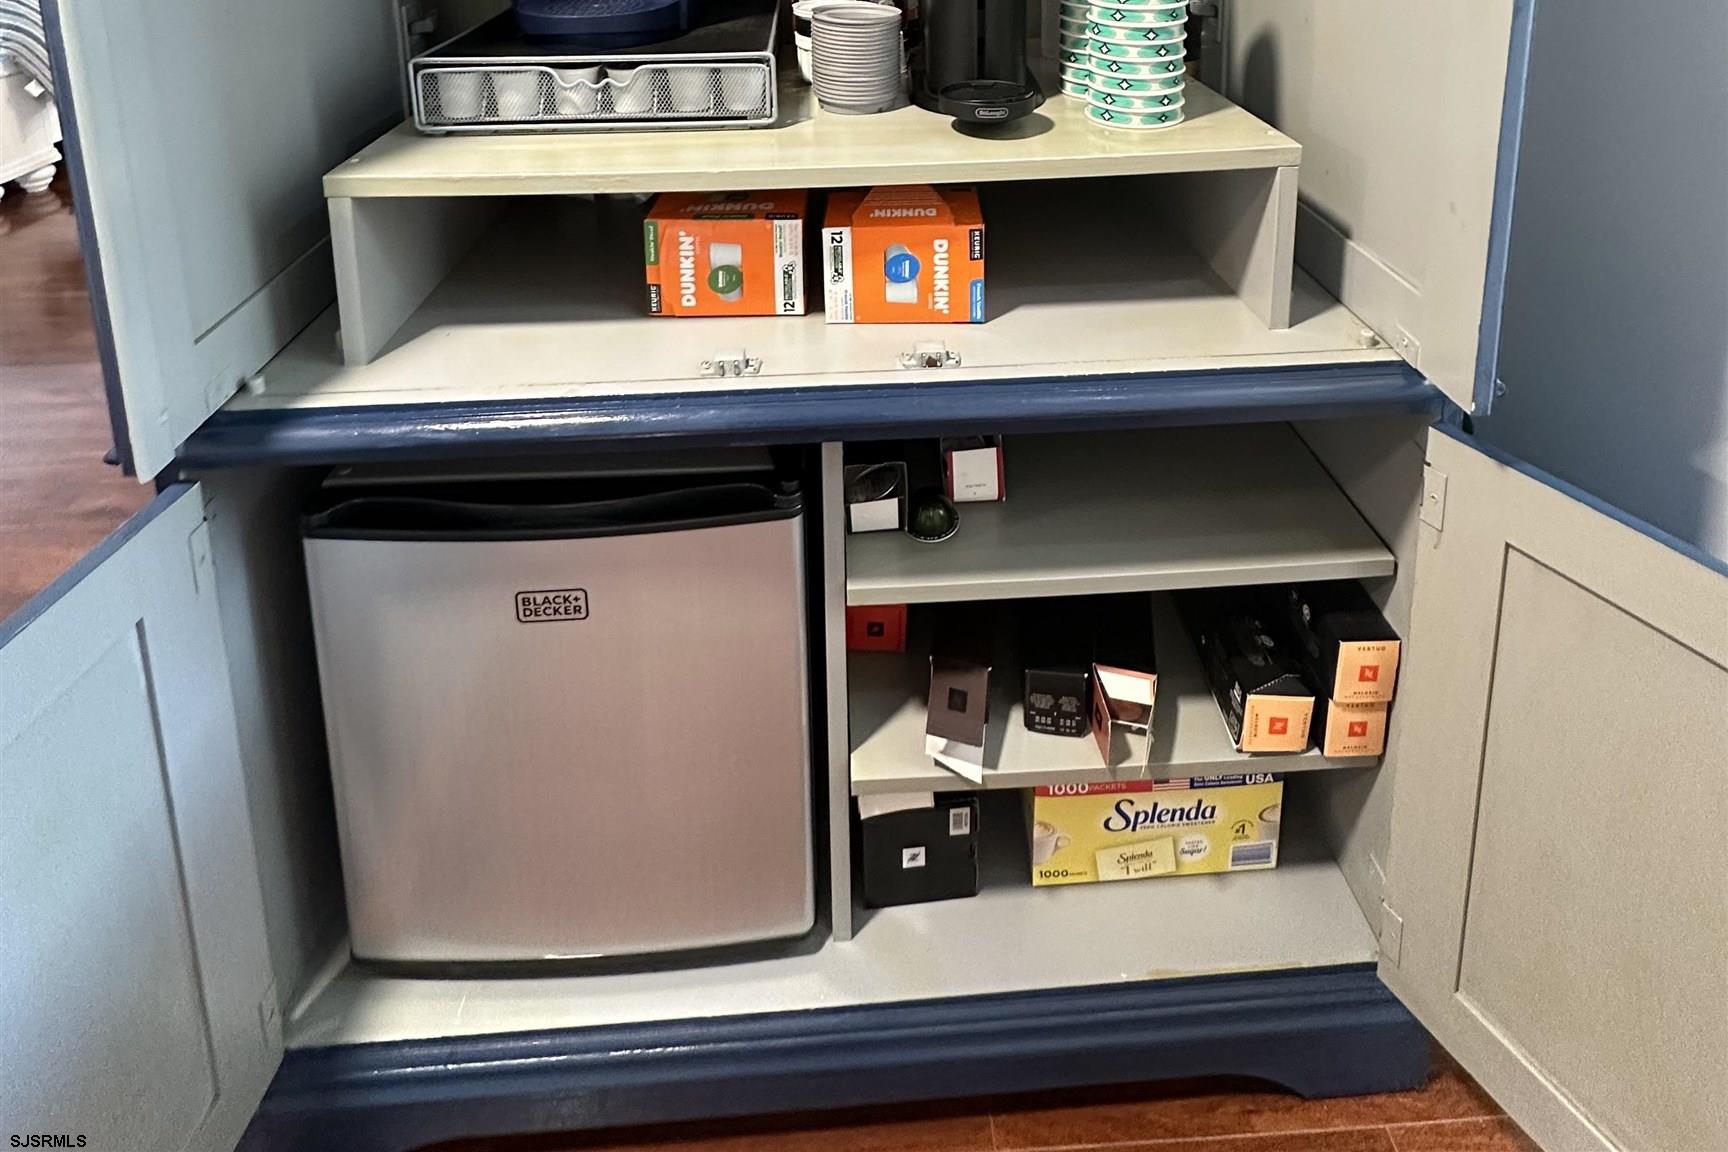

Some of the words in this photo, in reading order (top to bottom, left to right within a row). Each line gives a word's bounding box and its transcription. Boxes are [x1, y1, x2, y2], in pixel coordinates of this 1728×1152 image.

[870, 207, 937, 218] DUNKIN'
[830, 231, 843, 244] 12
[973, 231, 981, 259] KEURIG
[678, 231, 697, 308] DUNKIN'
[933, 239, 949, 315] DUNKIN'
[650, 285, 658, 313] KEURIG
[783, 301, 796, 313] 12
[522, 594, 581, 607] BLACK+
[523, 605, 583, 618] DECKER
[1245, 773, 1274, 785] USA
[1049, 783, 1089, 796] 1000
[1103, 798, 1217, 832] Splenda
[1116, 850, 1153, 864] Splenda
[1179, 846, 1208, 856] Sugar!
[1039, 870, 1069, 879] 1000
